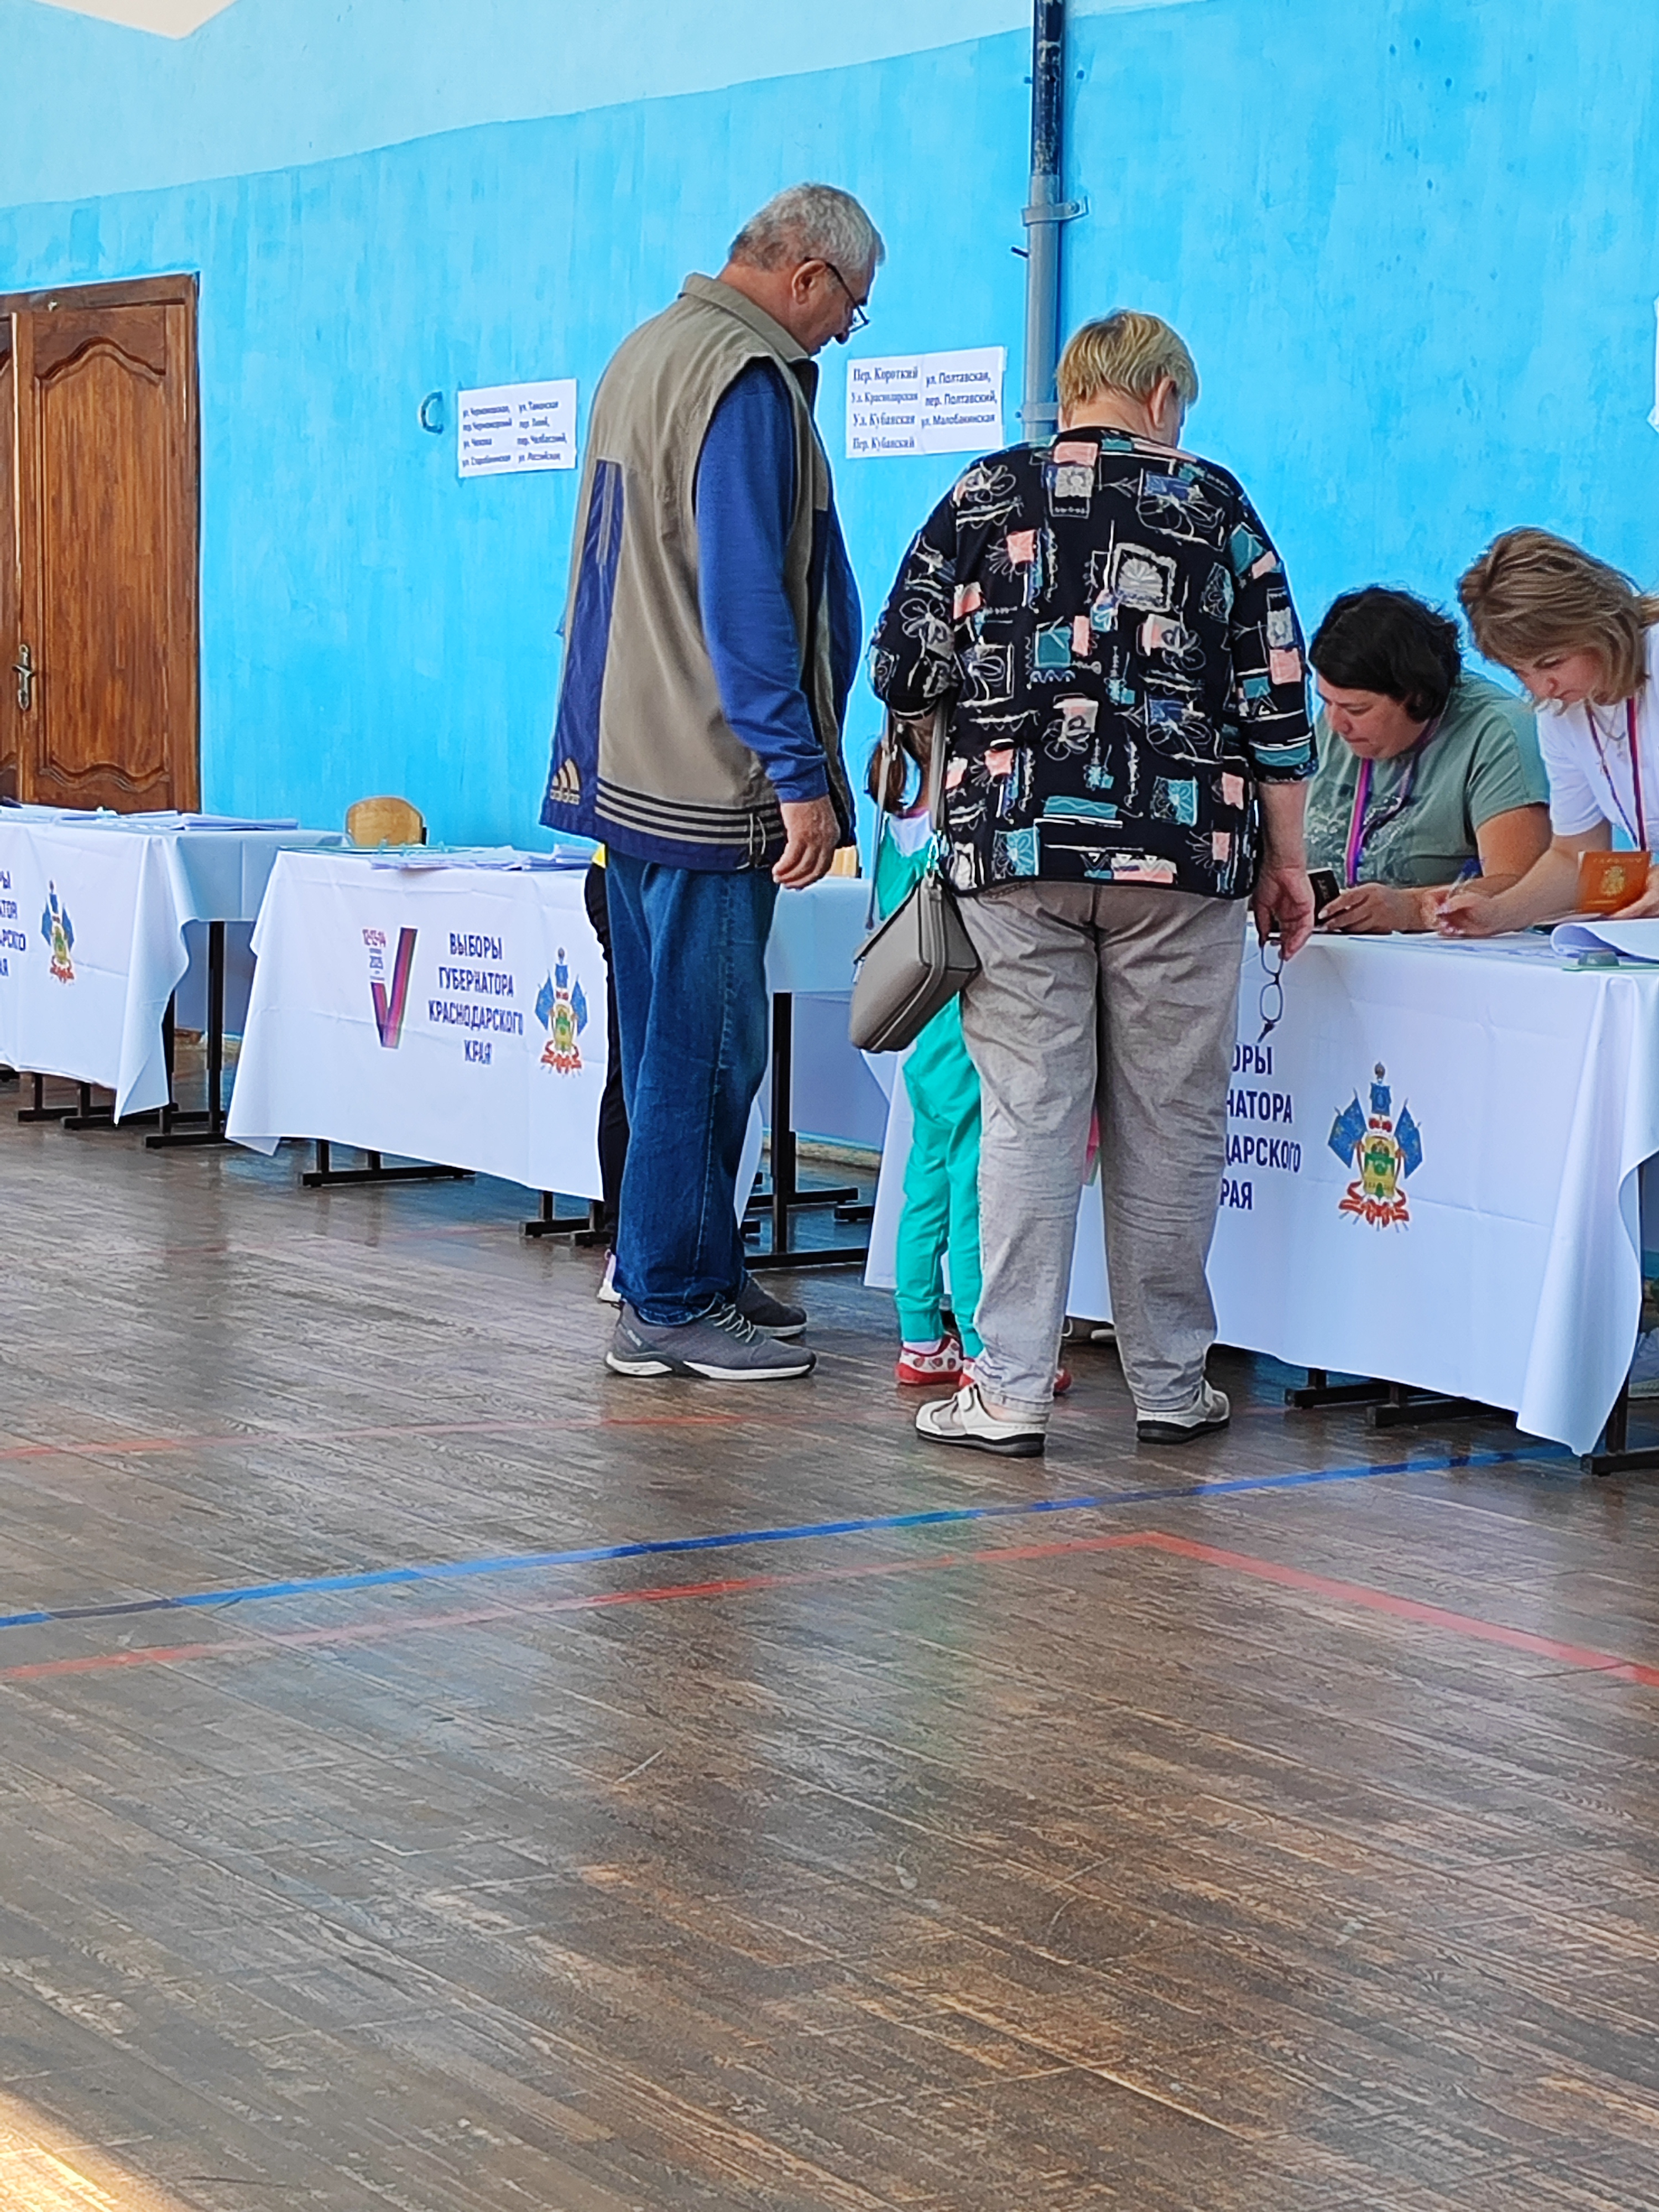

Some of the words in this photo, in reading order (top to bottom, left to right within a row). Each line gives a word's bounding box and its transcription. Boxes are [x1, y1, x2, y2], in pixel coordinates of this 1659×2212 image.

[874, 366, 918, 384] Короткий
[450, 932, 503, 959] ВЫБОРЫ
[439, 966, 514, 998] ГУБЕРНАТОРА
[429, 1000, 523, 1036] КРАСНОДАРСКОГО
[464, 1040, 492, 1065] КРАЯ
